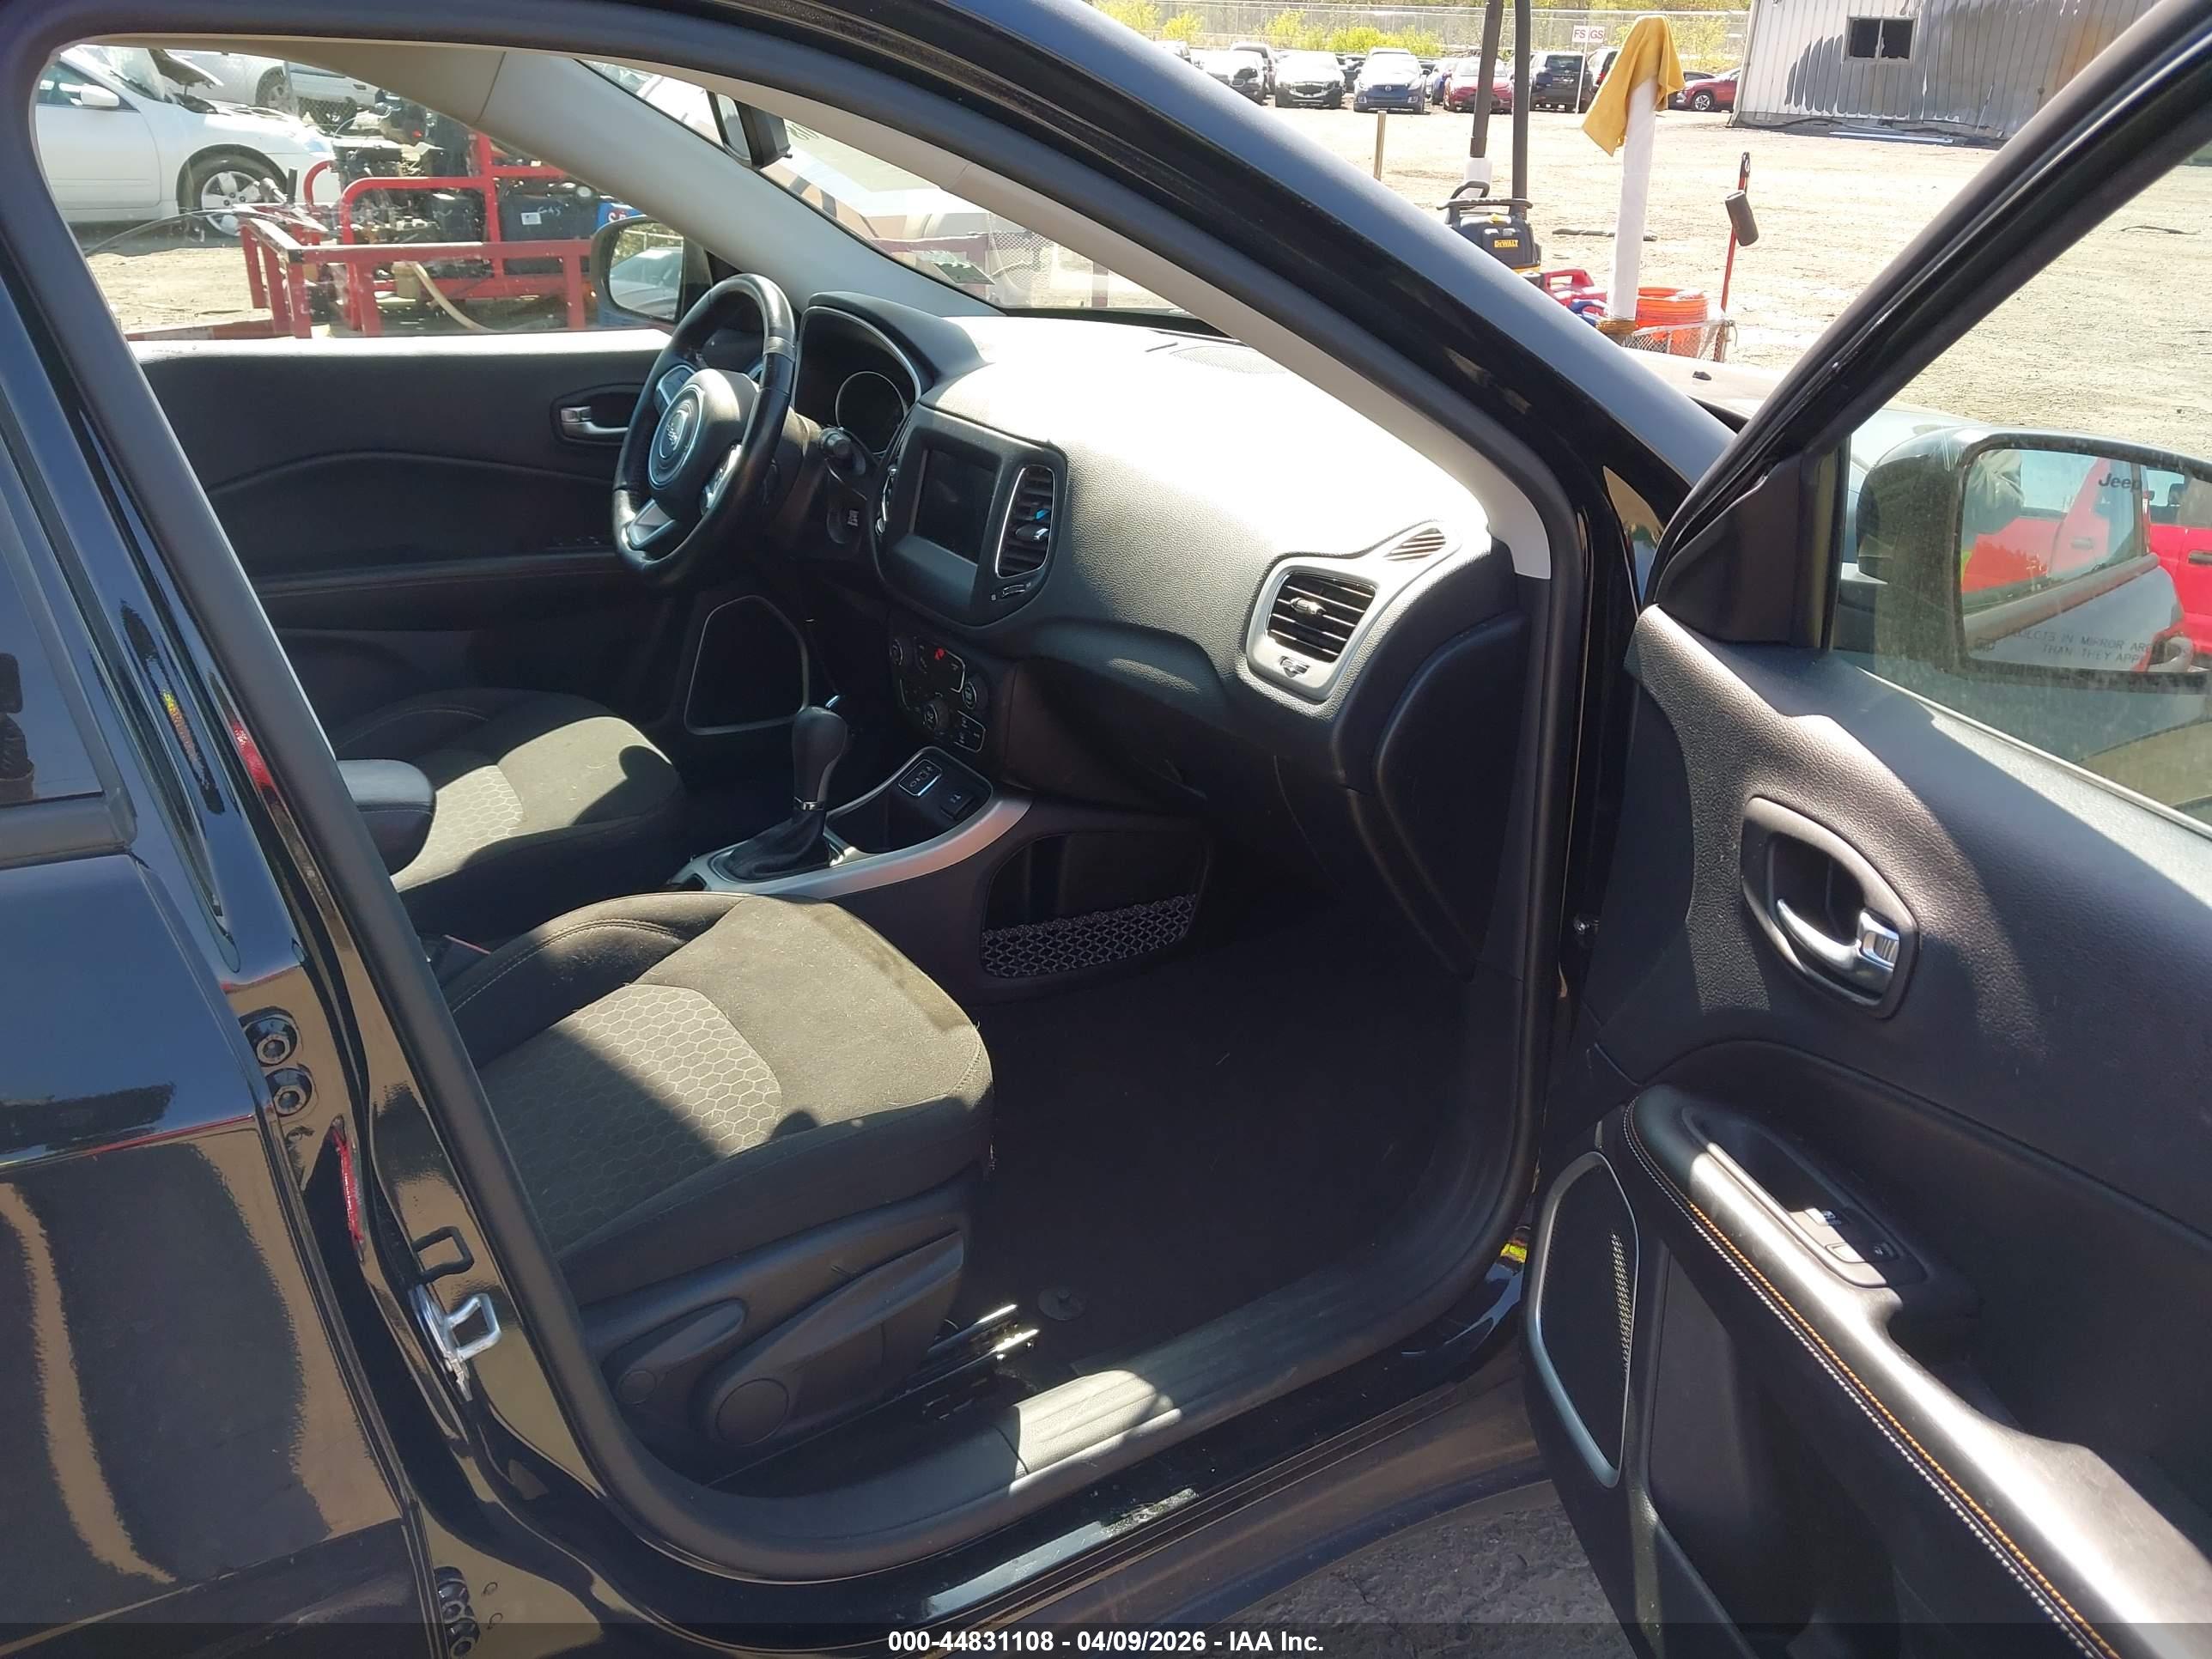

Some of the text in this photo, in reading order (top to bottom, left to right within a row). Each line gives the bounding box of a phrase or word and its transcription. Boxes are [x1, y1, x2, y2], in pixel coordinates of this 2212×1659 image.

[1574, 29, 1604, 40] FS GS
[537, 206, 562, 217] GAS
[2081, 635, 2124, 650] MIRROR
[2042, 644, 2074, 656] THAN
[2081, 647, 2112, 661] THEY
